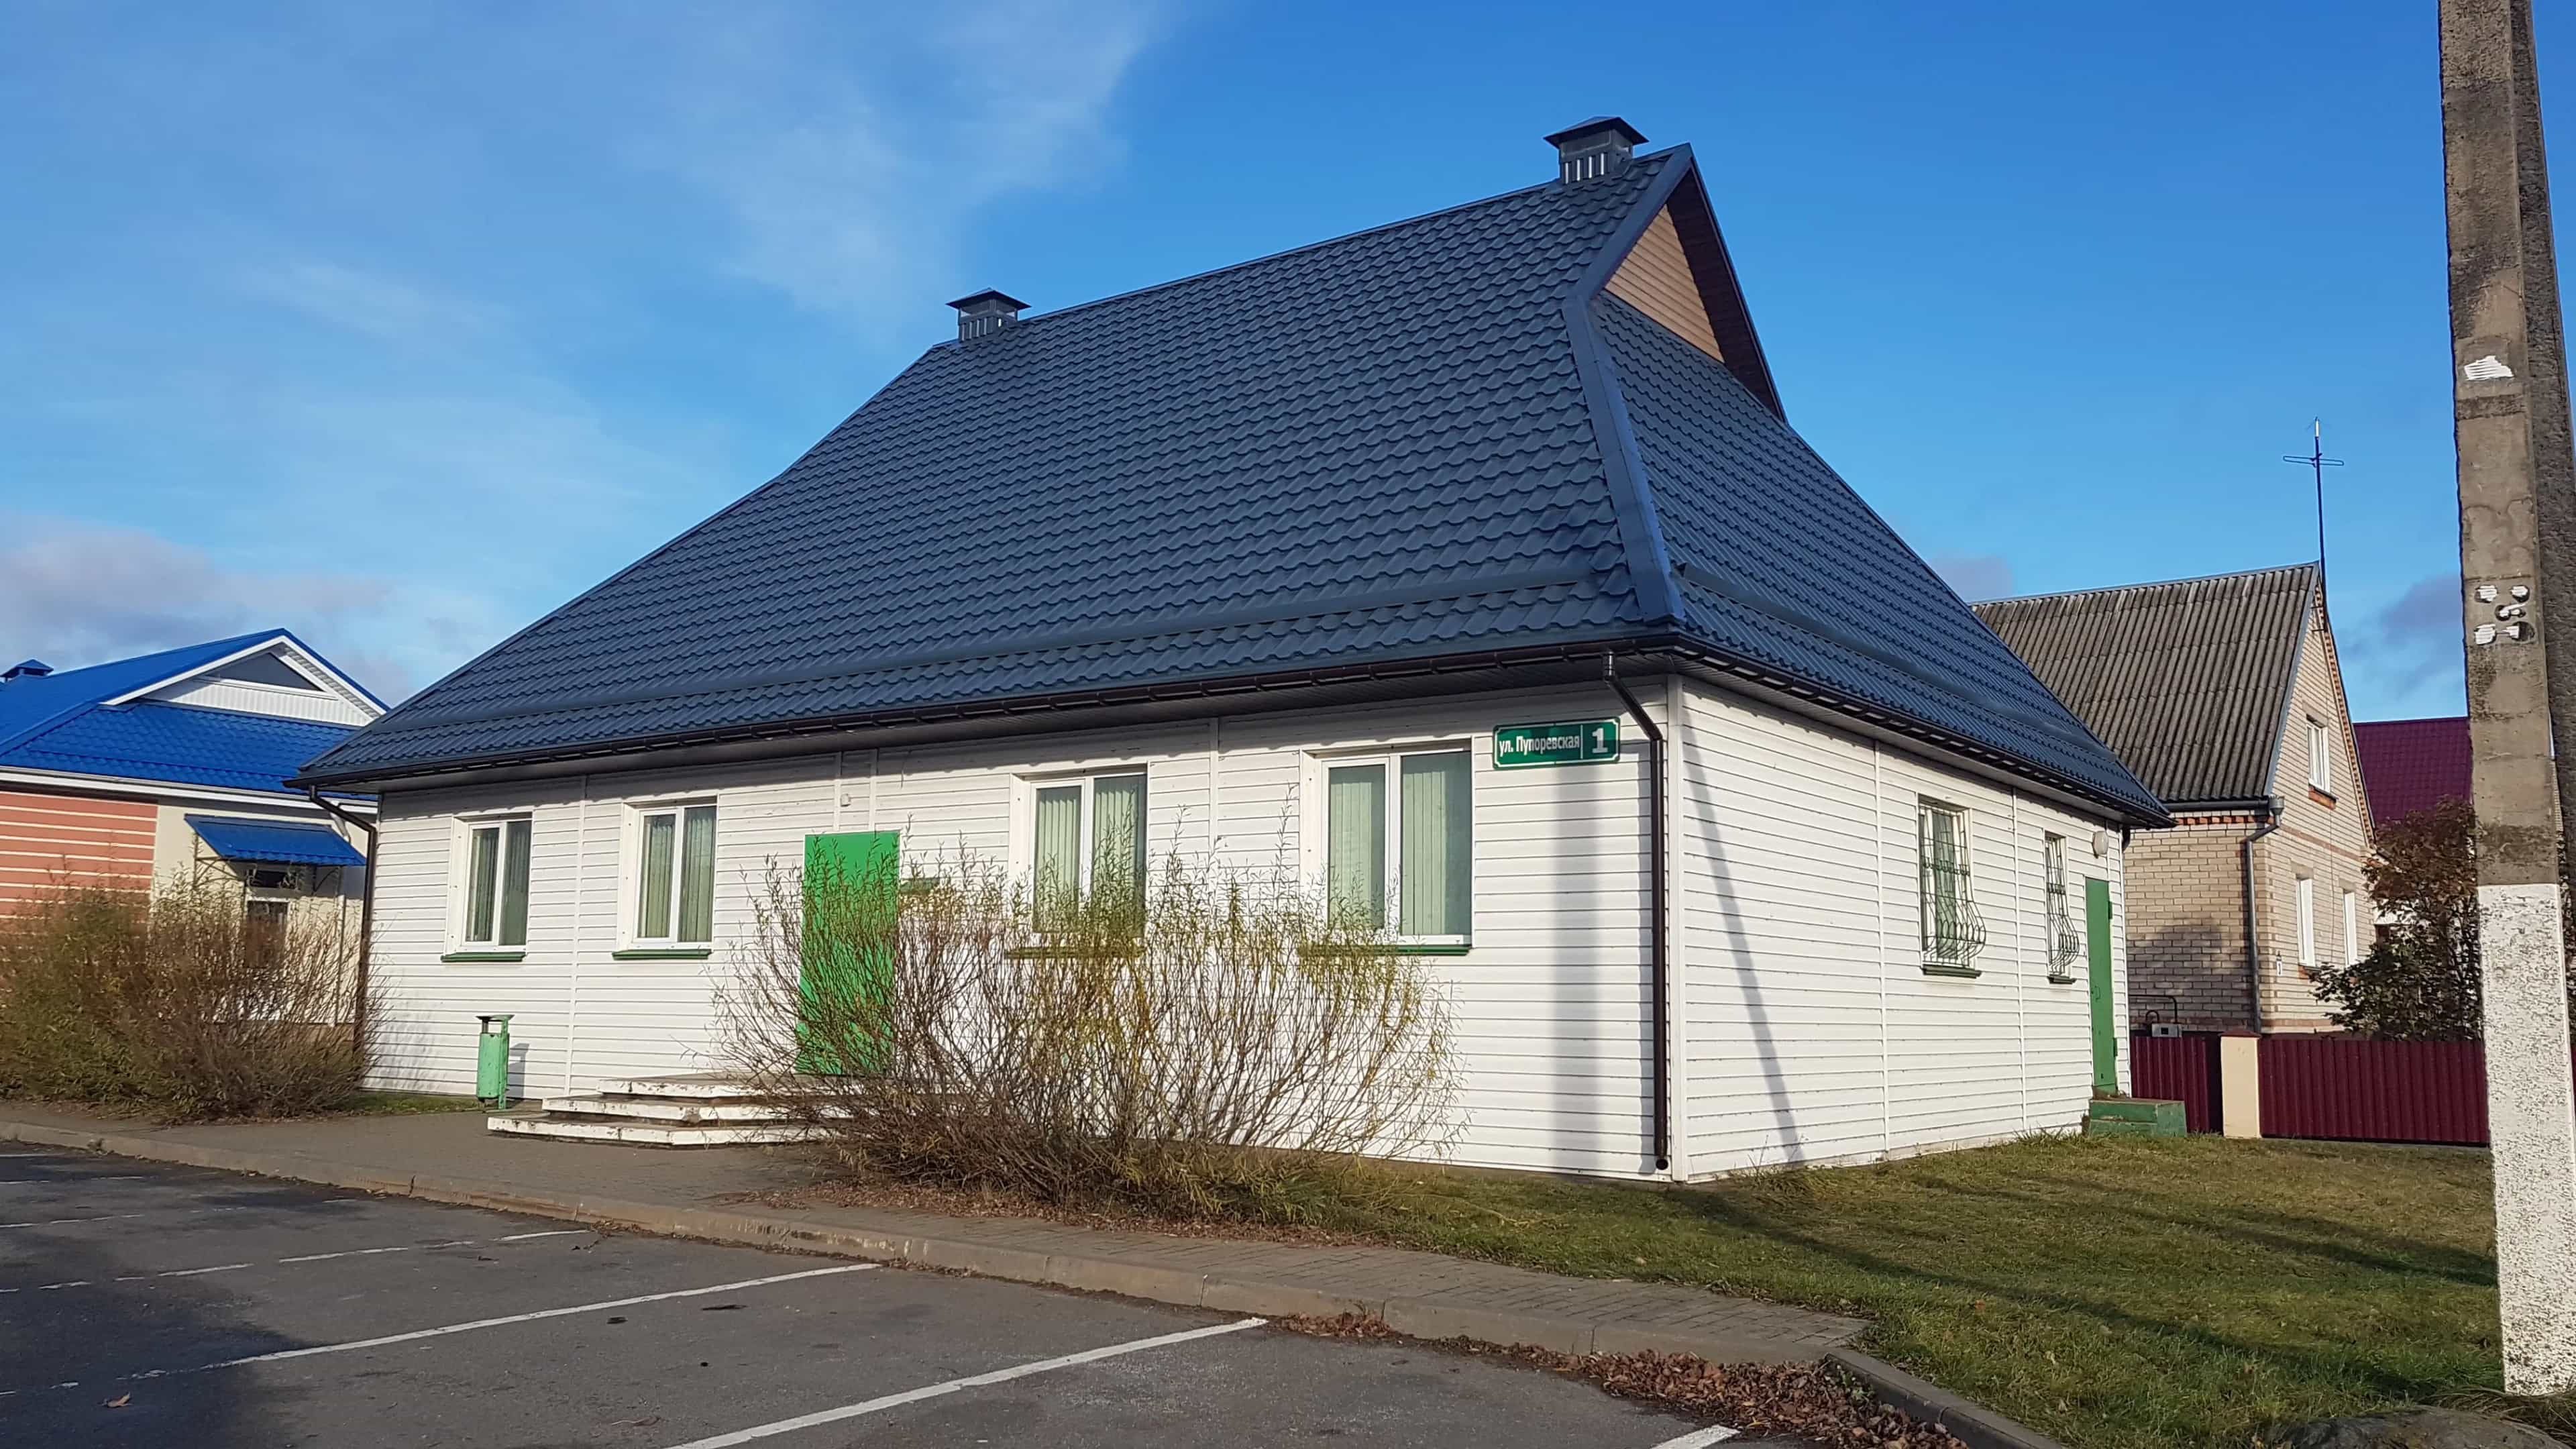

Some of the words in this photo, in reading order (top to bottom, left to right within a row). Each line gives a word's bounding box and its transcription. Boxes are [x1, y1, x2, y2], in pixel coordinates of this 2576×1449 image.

[1499, 740, 1513, 757] ул.
[1516, 735, 1580, 755] Пупоревская
[1592, 727, 1609, 753] 1
